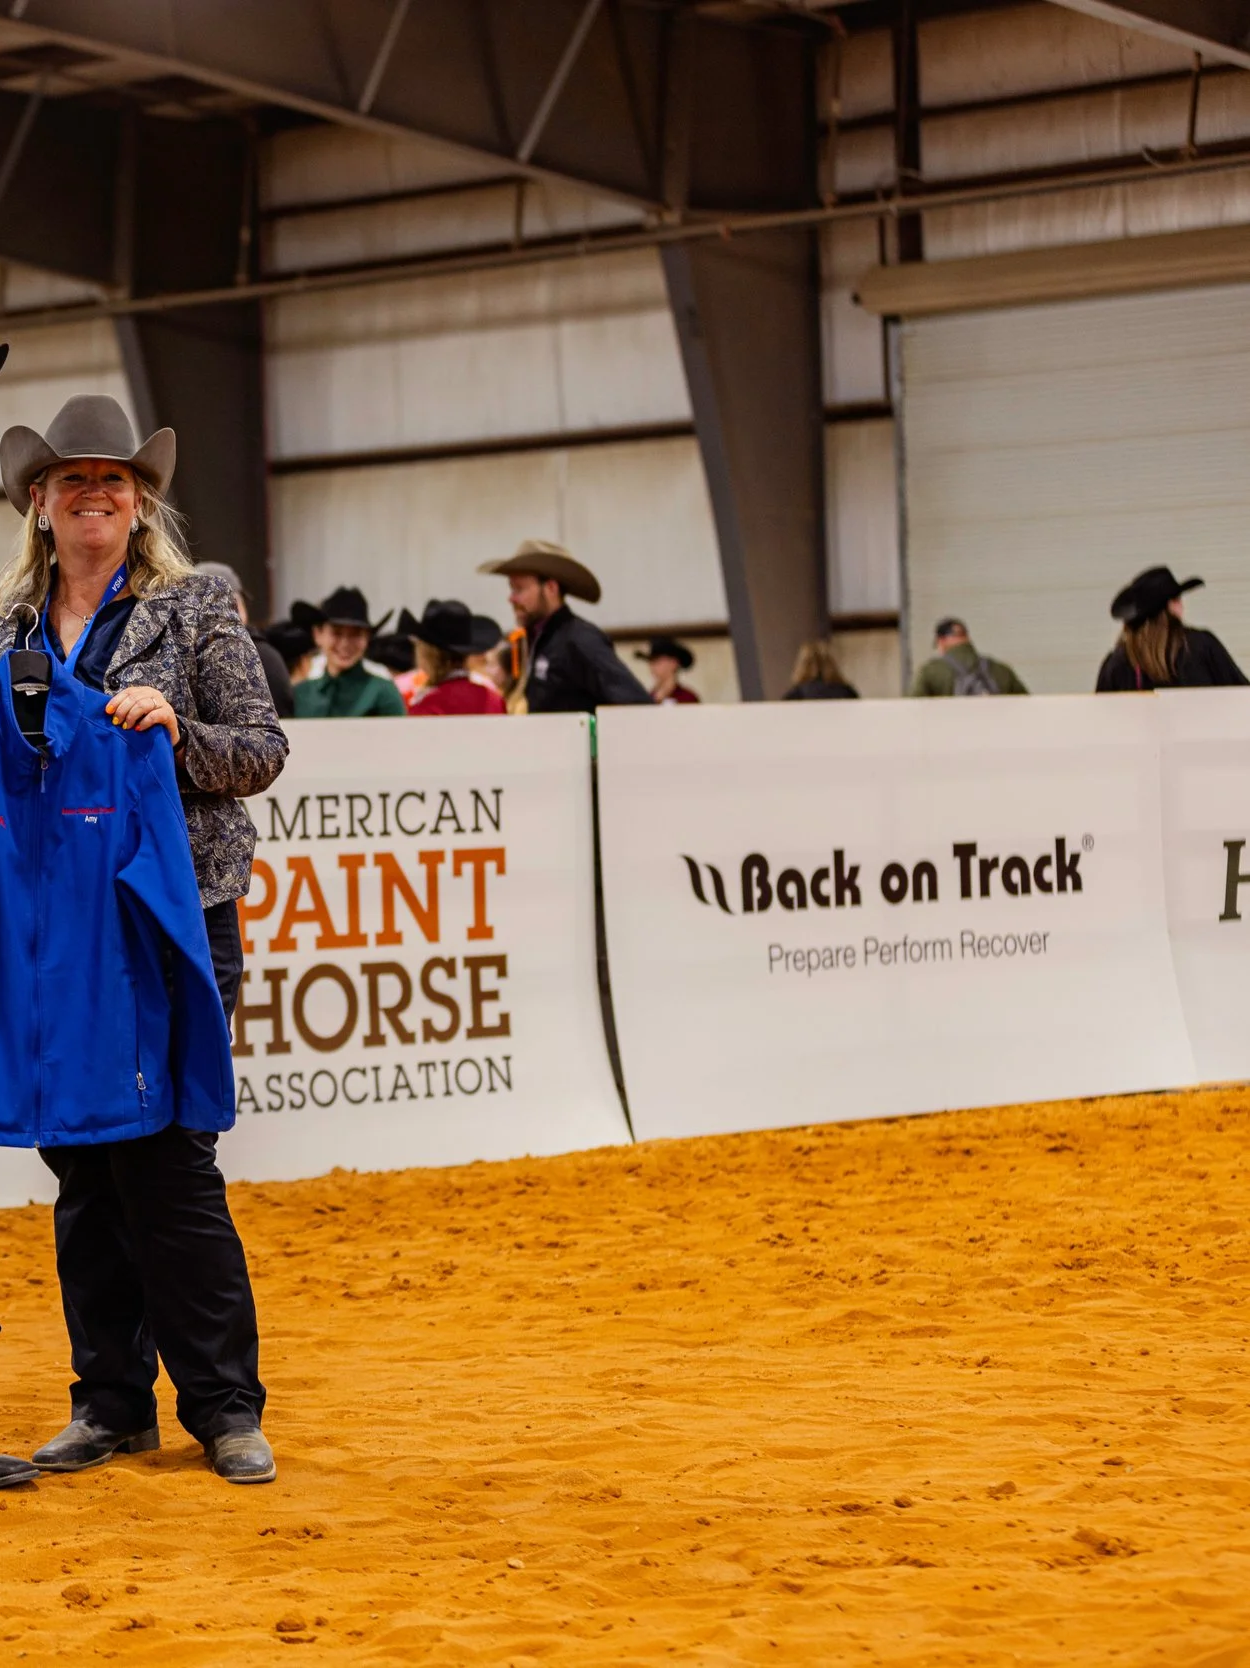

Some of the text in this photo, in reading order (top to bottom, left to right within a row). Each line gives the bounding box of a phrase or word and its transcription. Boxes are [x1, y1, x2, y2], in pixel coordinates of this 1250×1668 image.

[111, 575, 125, 592] IHSA
[236, 846, 506, 954] PAINT
[741, 849, 861, 914] Back
[880, 861, 938, 905] on
[768, 929, 1050, 976] Prepare Perform Recover
[231, 953, 512, 1057] HORSE
[236, 1055, 513, 1114] ASSOCIATION
